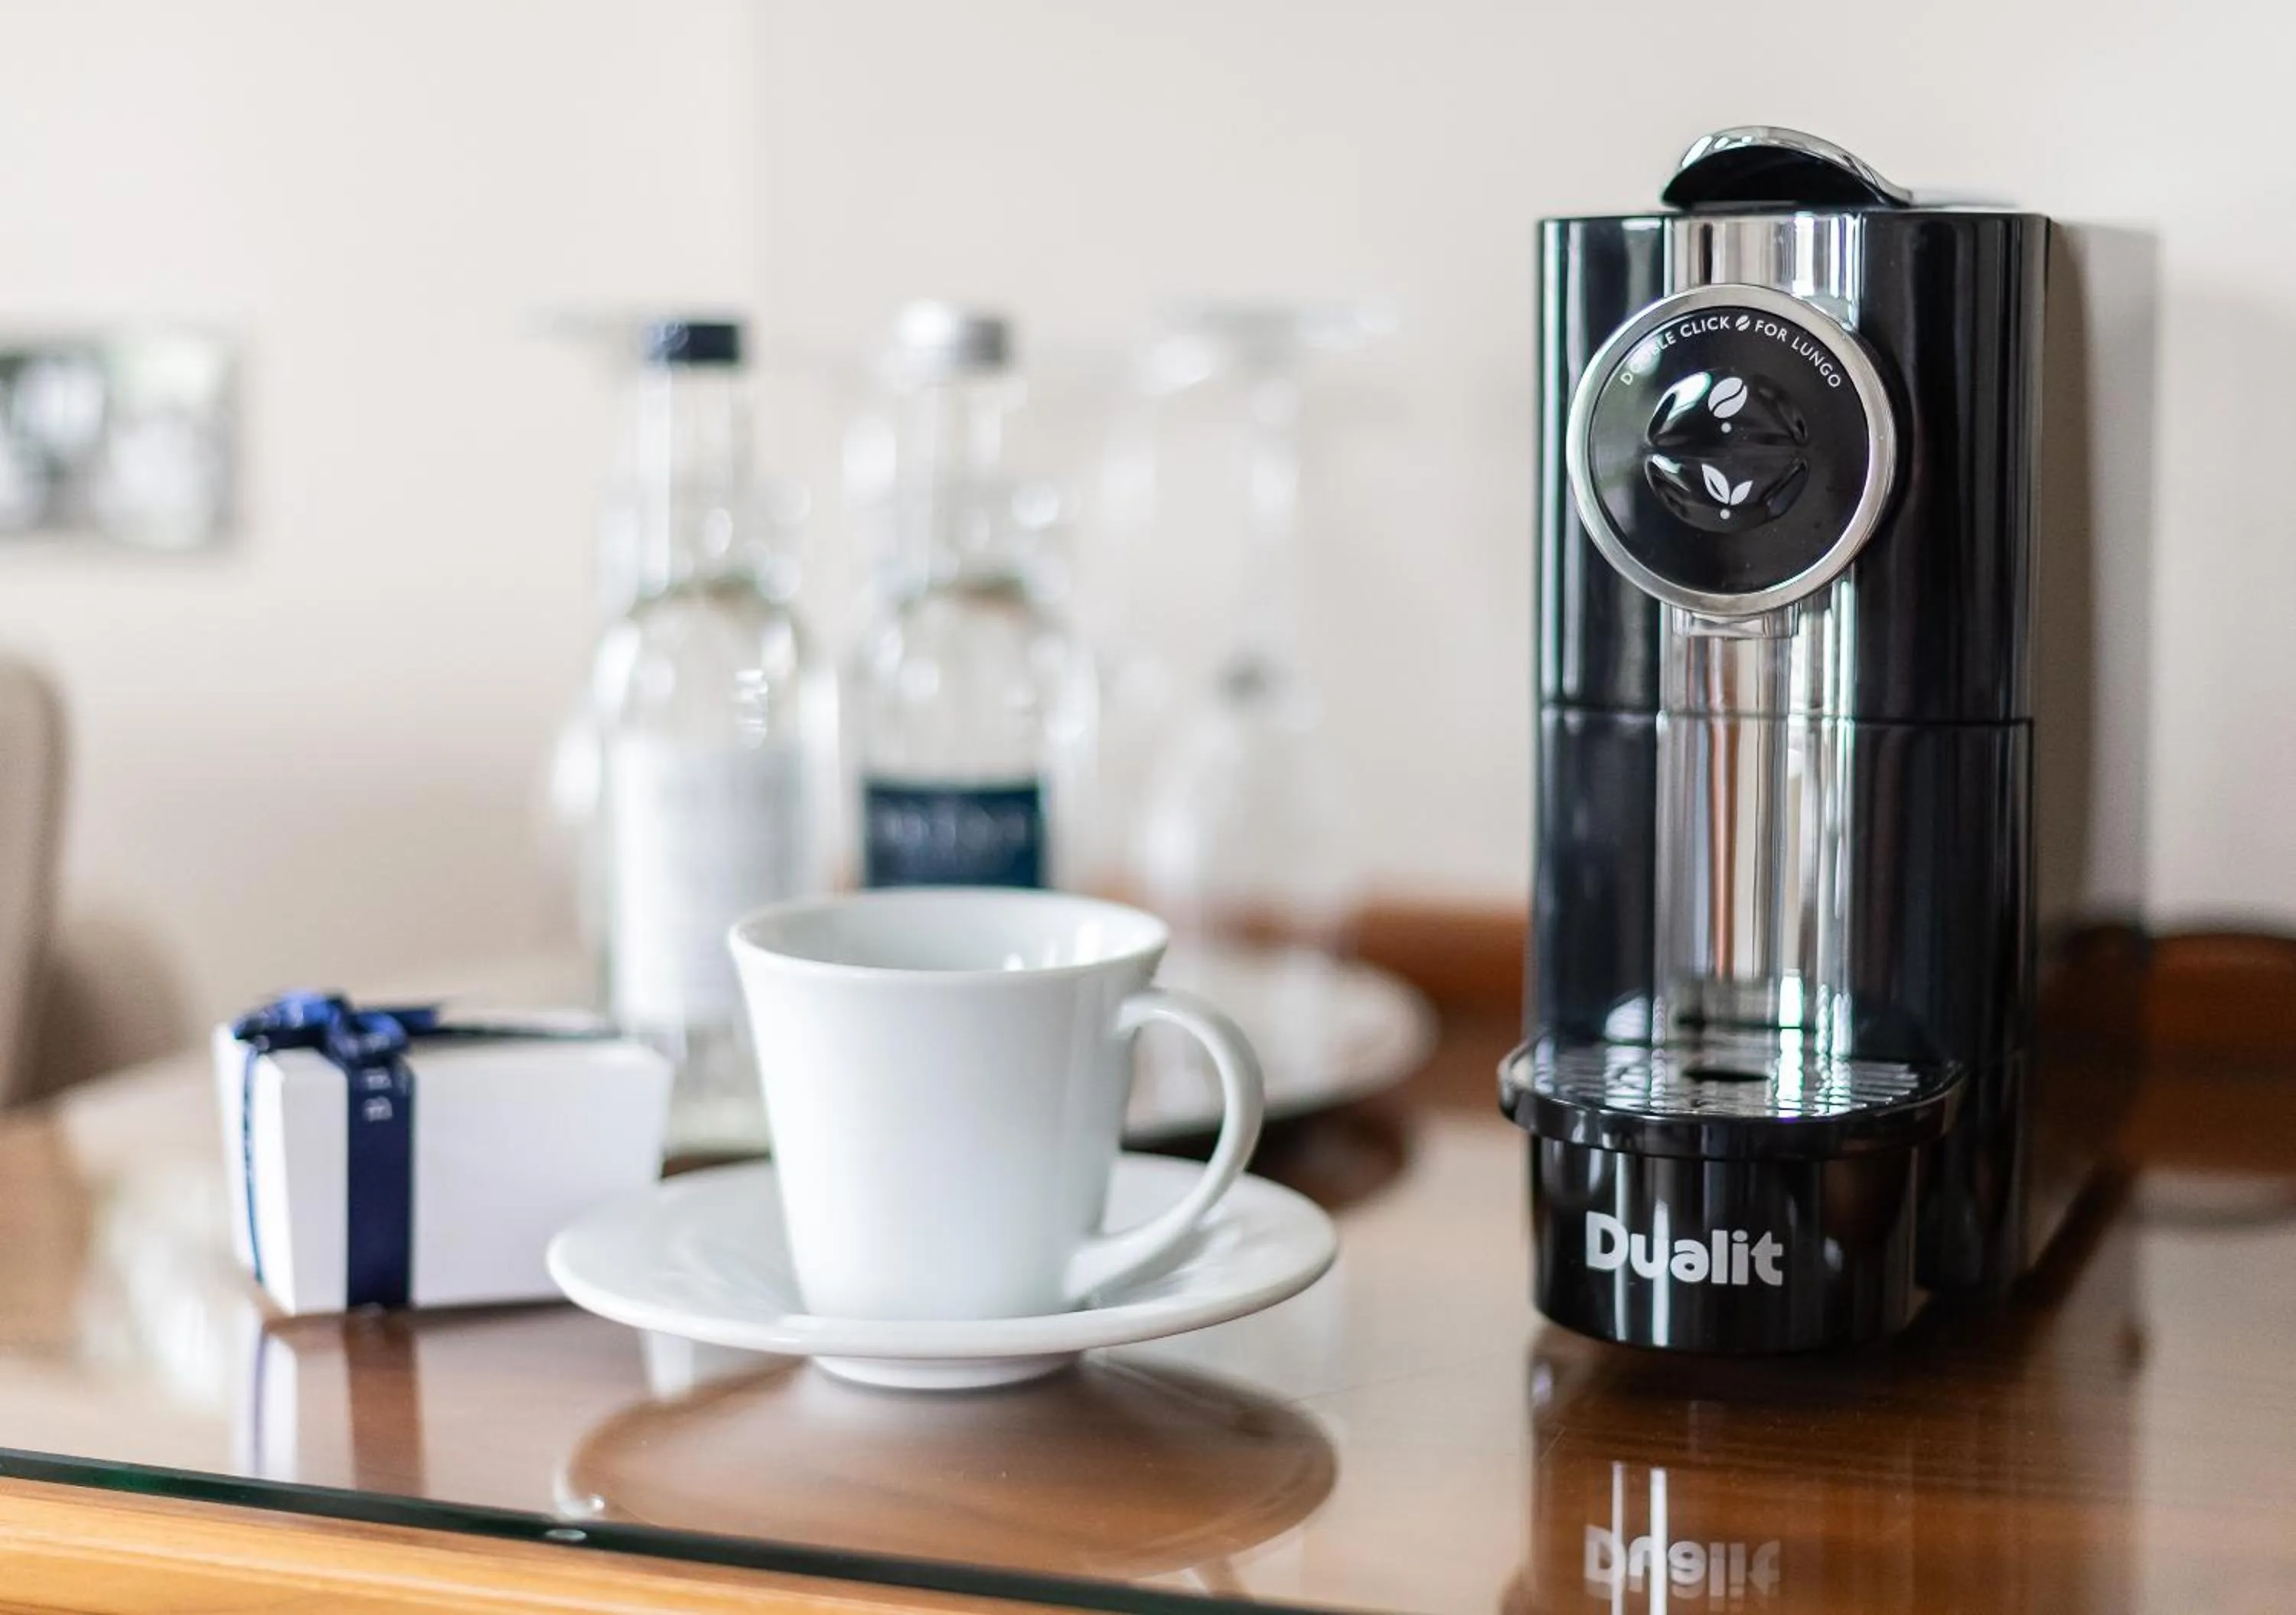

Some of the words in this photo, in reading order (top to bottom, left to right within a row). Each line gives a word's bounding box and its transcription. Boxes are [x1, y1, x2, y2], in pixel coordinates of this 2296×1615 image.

[1620, 331, 1676, 385] DOBLE
[1680, 316, 1730, 337] CLICK
[1755, 320, 1787, 341] FOR
[1791, 337, 1841, 387] LUNGO
[1586, 1211, 1783, 1286] Dualit
